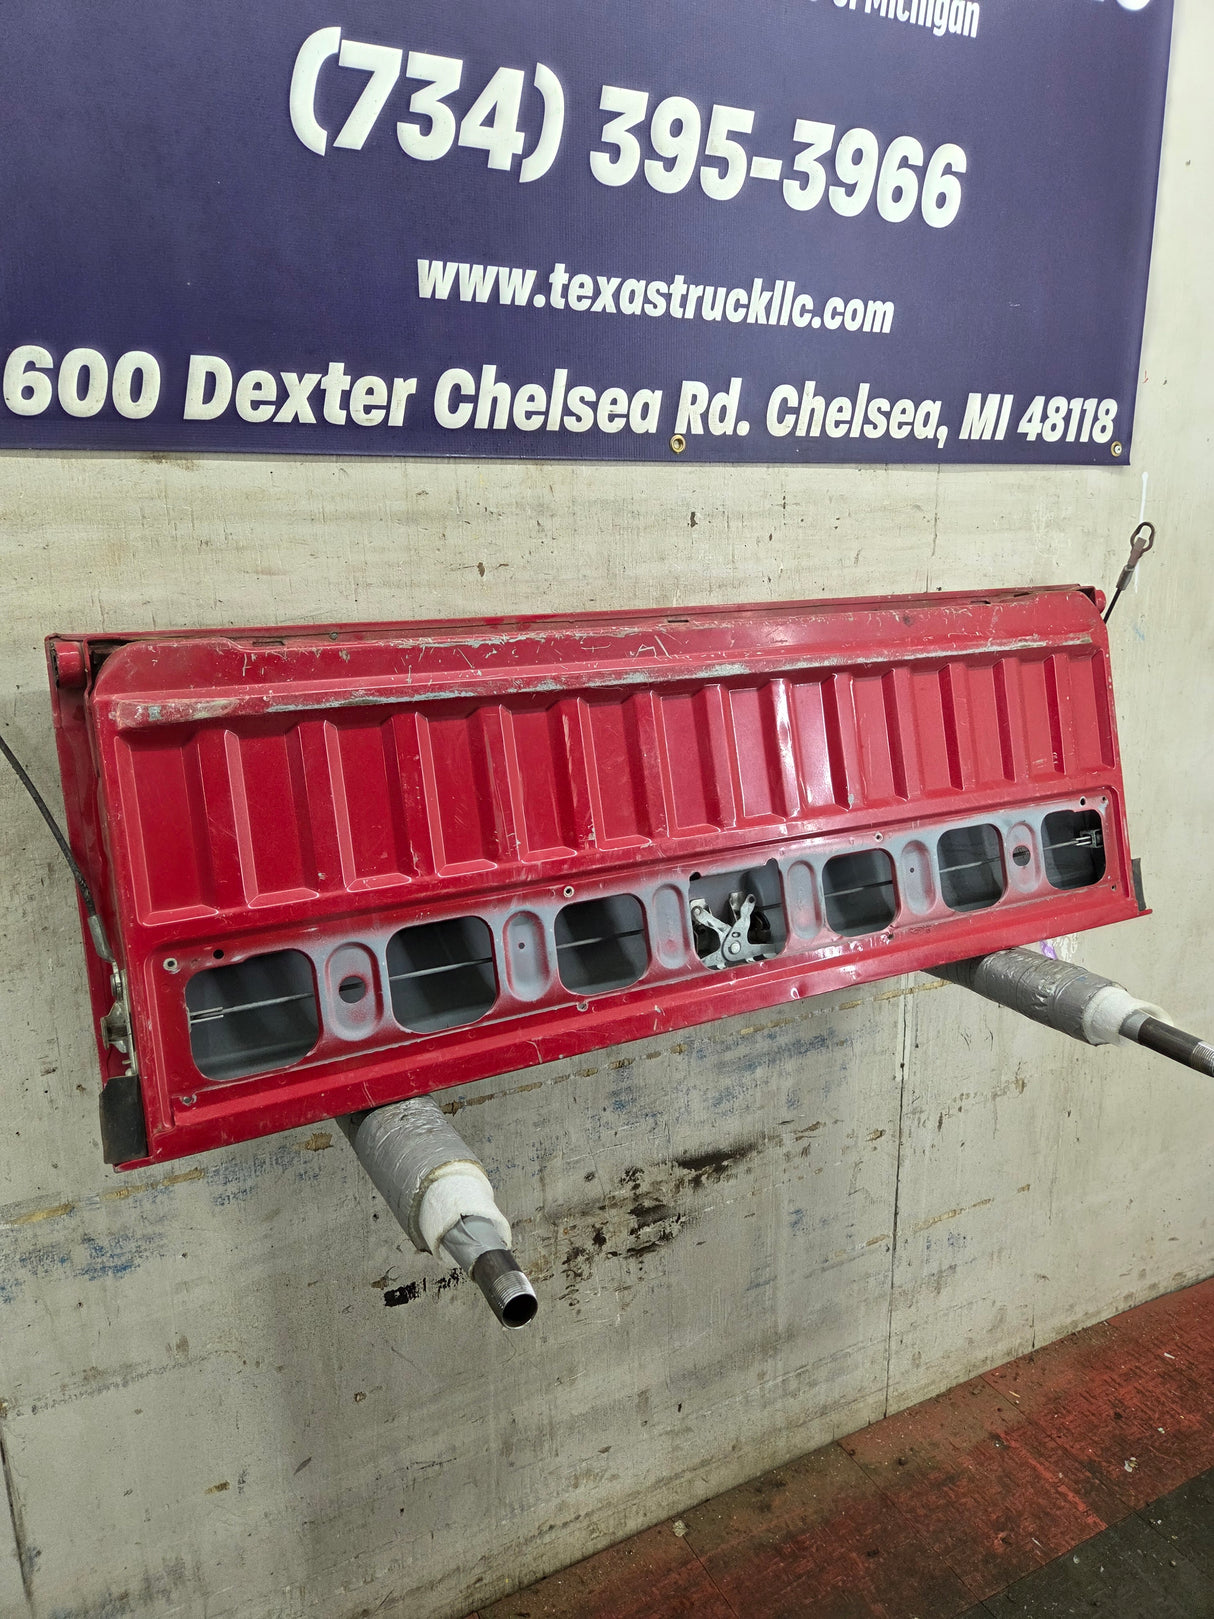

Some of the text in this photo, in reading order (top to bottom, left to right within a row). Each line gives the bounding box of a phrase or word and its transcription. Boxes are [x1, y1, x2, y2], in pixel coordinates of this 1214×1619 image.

[290, 27, 967, 228] (734) 395-3966
[418, 259, 894, 333] www.texastruckllc.com
[3, 345, 1117, 448] 600 Dexter Chelsea Rd. Chelsea, MI 48118
